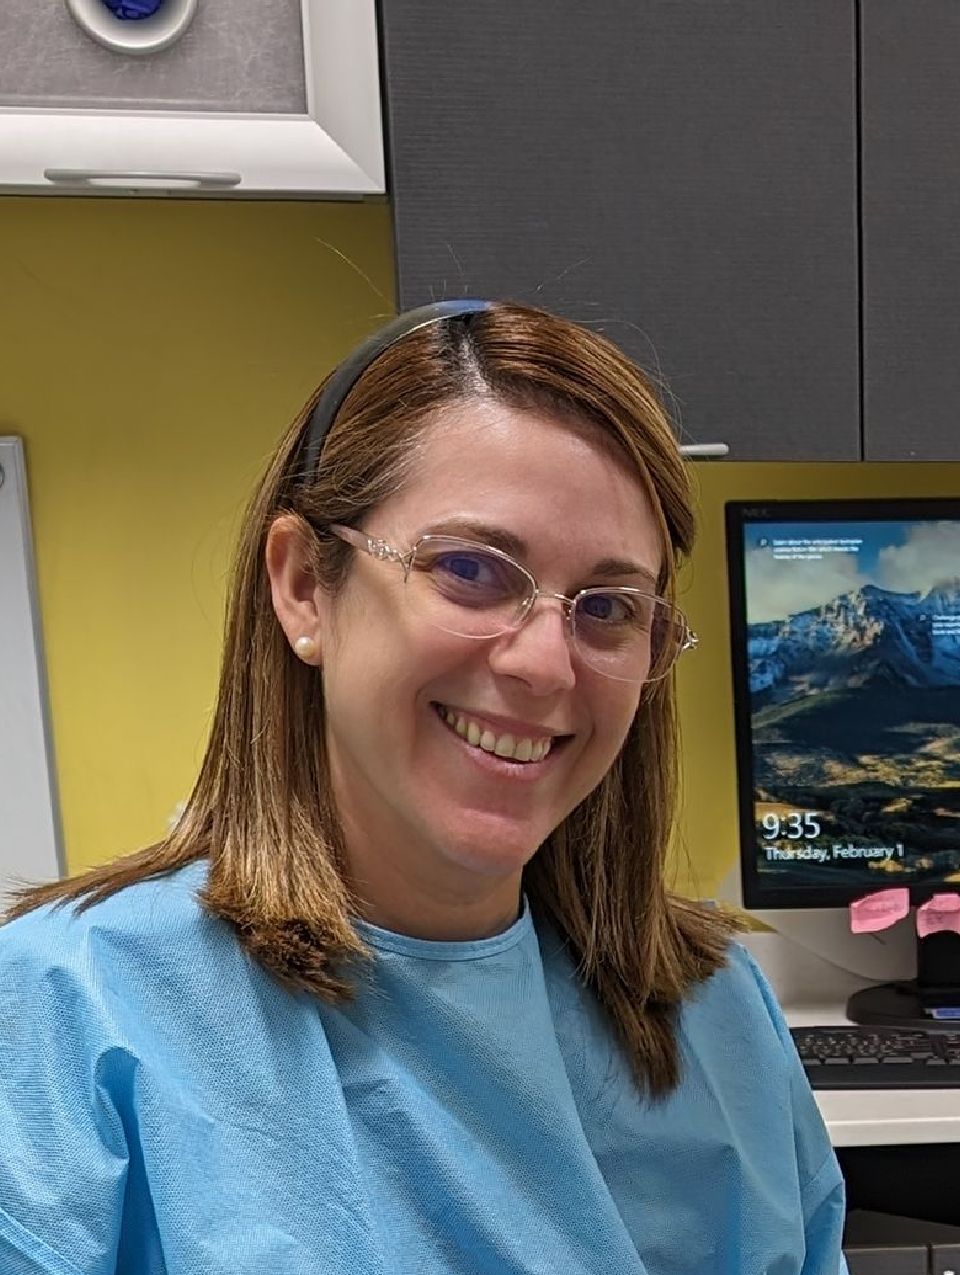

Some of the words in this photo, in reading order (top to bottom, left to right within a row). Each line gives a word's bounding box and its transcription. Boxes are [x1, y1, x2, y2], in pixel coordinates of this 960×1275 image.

[761, 811, 821, 840] 9:35
[764, 845, 831, 863] Thursday,
[831, 843, 895, 861] February
[896, 843, 905, 857] 1
